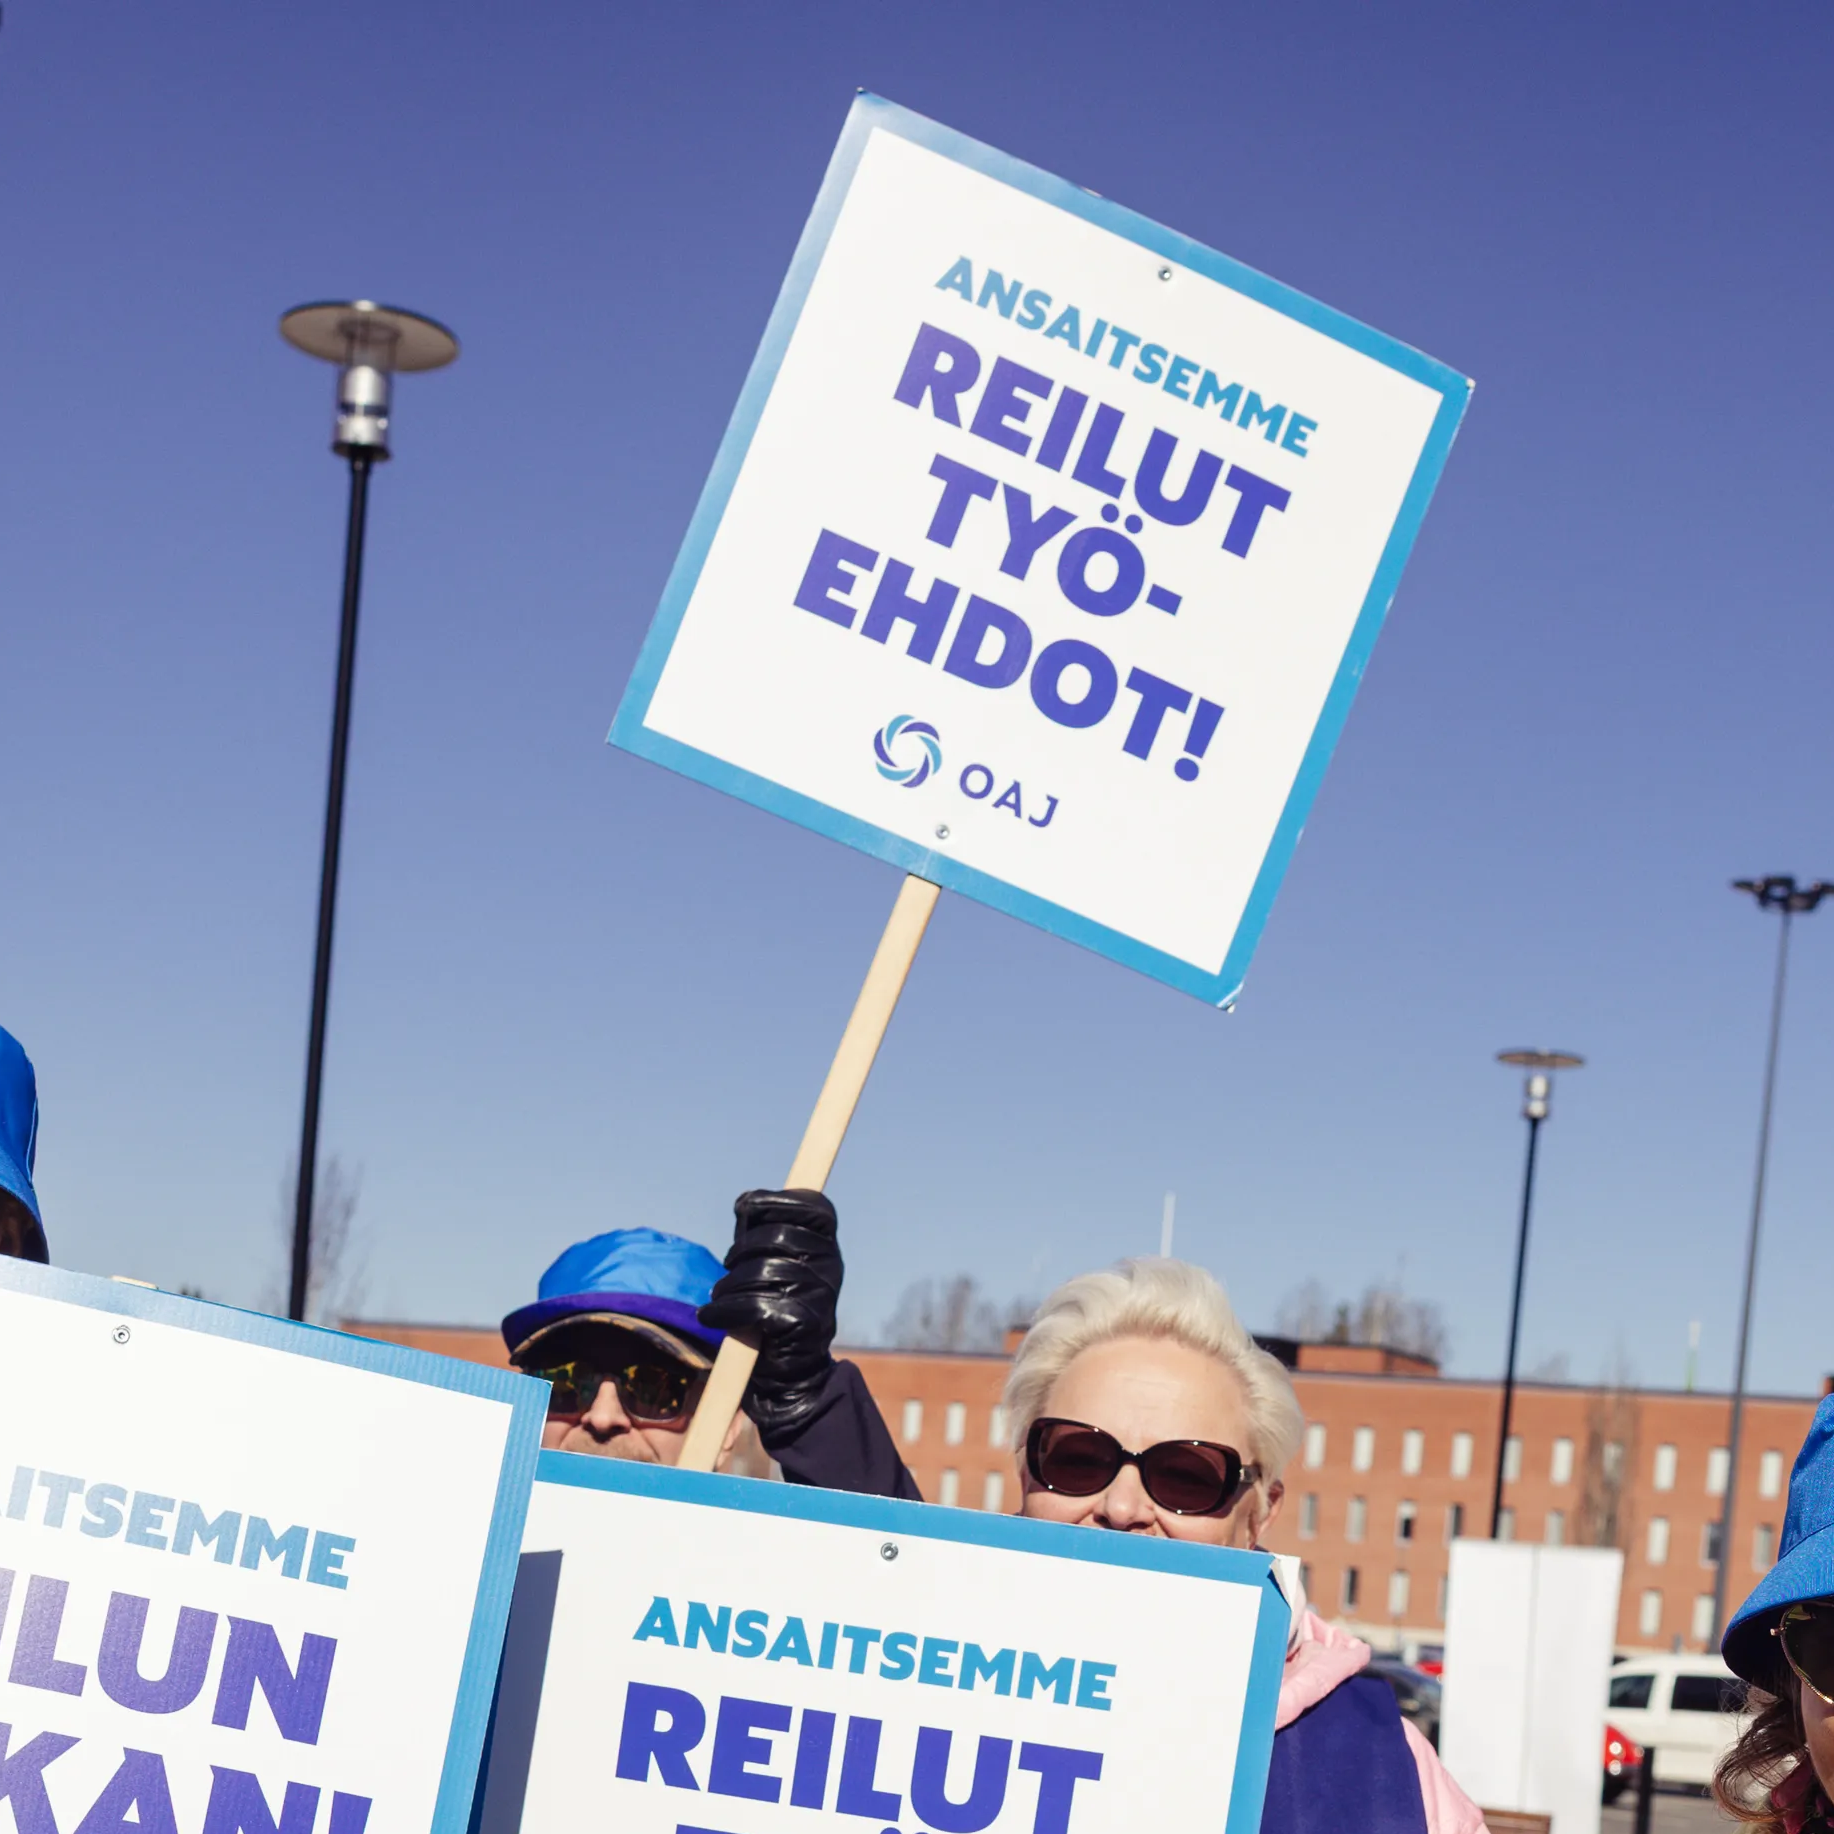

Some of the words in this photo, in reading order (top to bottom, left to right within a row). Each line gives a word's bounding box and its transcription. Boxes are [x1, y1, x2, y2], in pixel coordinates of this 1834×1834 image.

[895, 324, 1291, 558] REILUT
[938, 259, 1318, 457] ANSAITSEMME
[927, 454, 1182, 617] TYÖ-
[795, 529, 1224, 782] EHDOT!
[958, 763, 1059, 830] OAJ
[633, 1595, 1117, 1711] ANSAITSEMME
